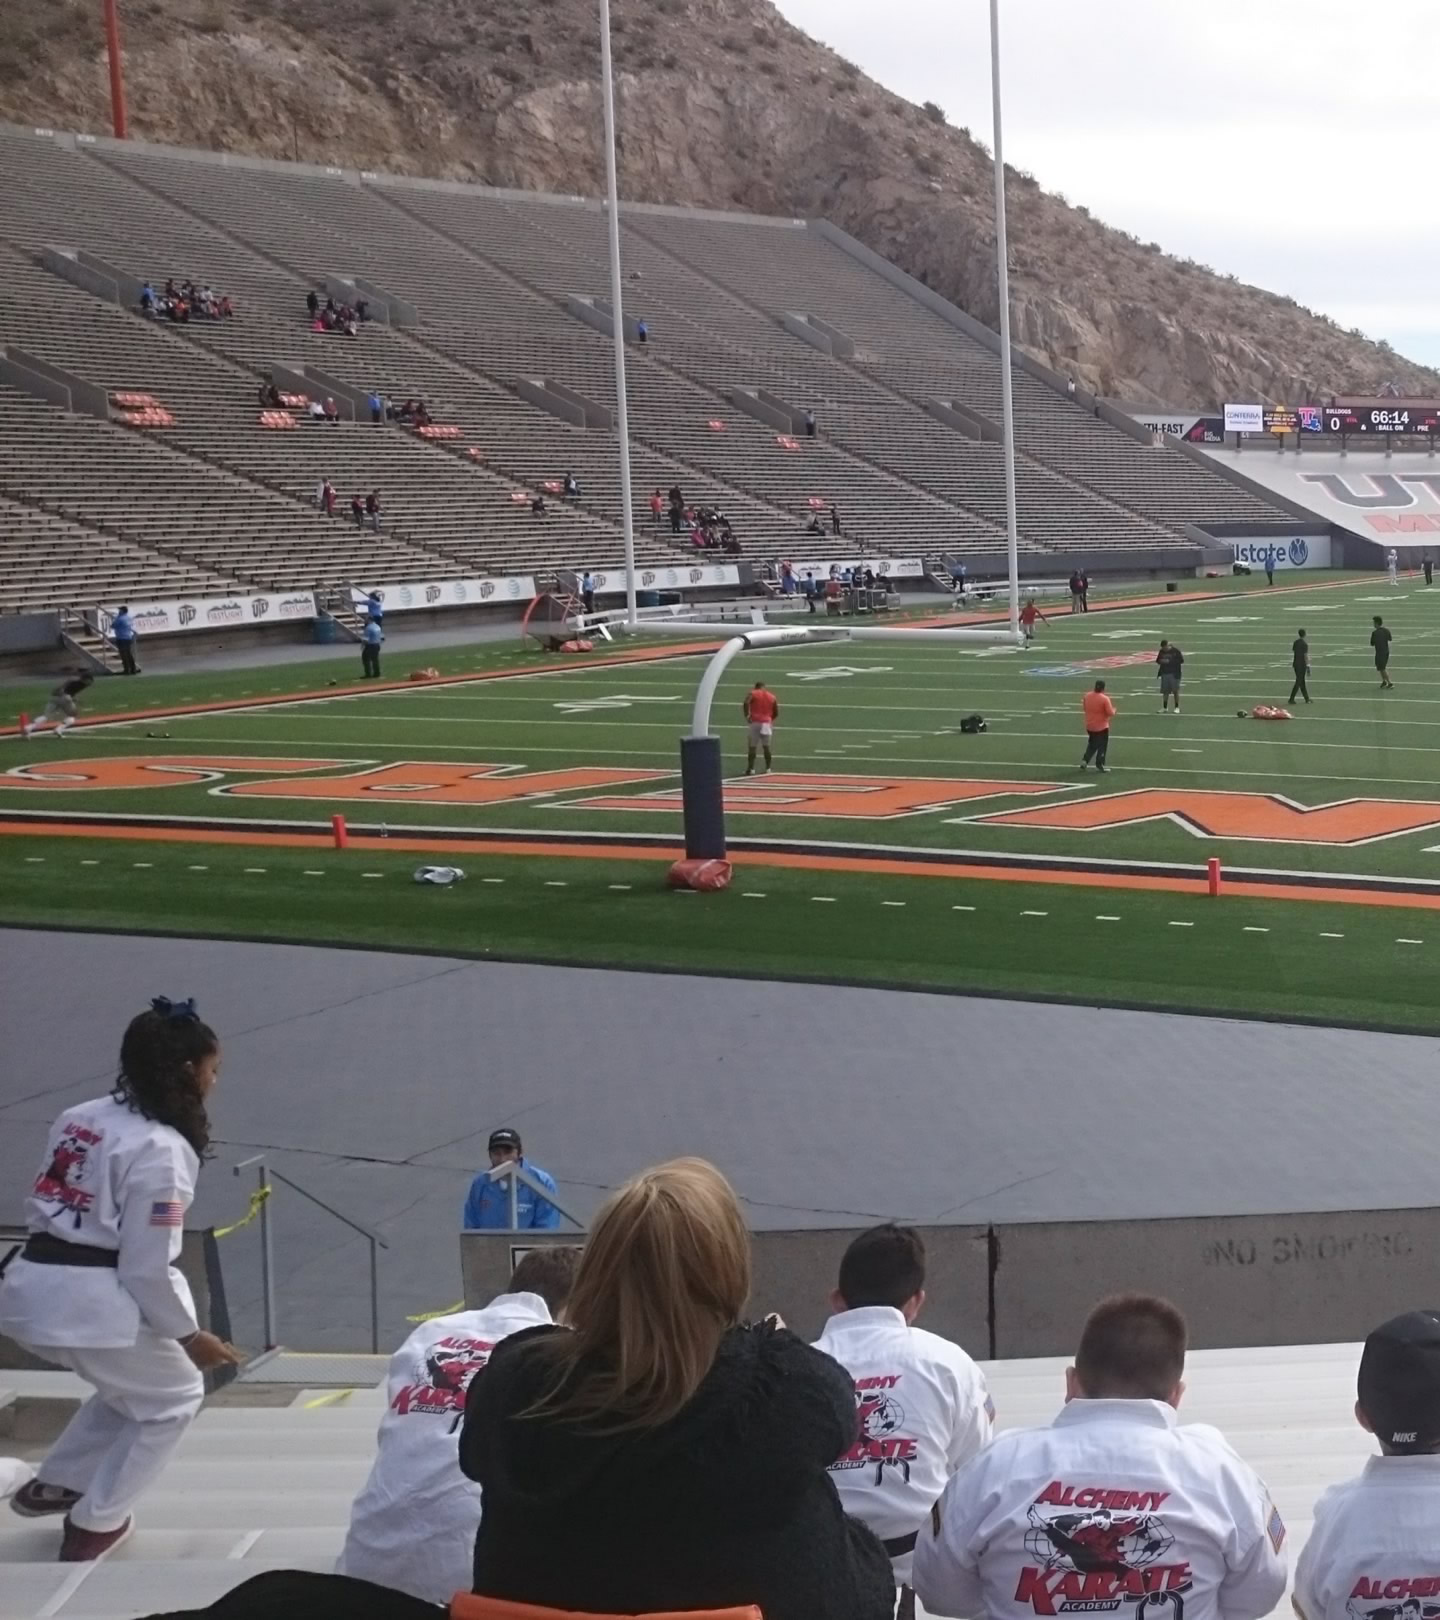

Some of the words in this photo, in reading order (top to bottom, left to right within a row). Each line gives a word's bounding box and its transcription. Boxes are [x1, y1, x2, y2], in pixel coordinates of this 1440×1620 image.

[1371, 411, 1409, 424] 66:14
[1144, 423, 1185, 434] TH-EAST
[1331, 418, 1340, 430] 0
[1214, 1239, 1257, 1266] NO
[1392, 1432, 1417, 1442] NIKE
[825, 1461, 864, 1471] ACADEMY
[1034, 1481, 1171, 1511] ALCHEMY
[1014, 1562, 1193, 1616] KARATE
[1062, 1601, 1119, 1611] ACADEMY
